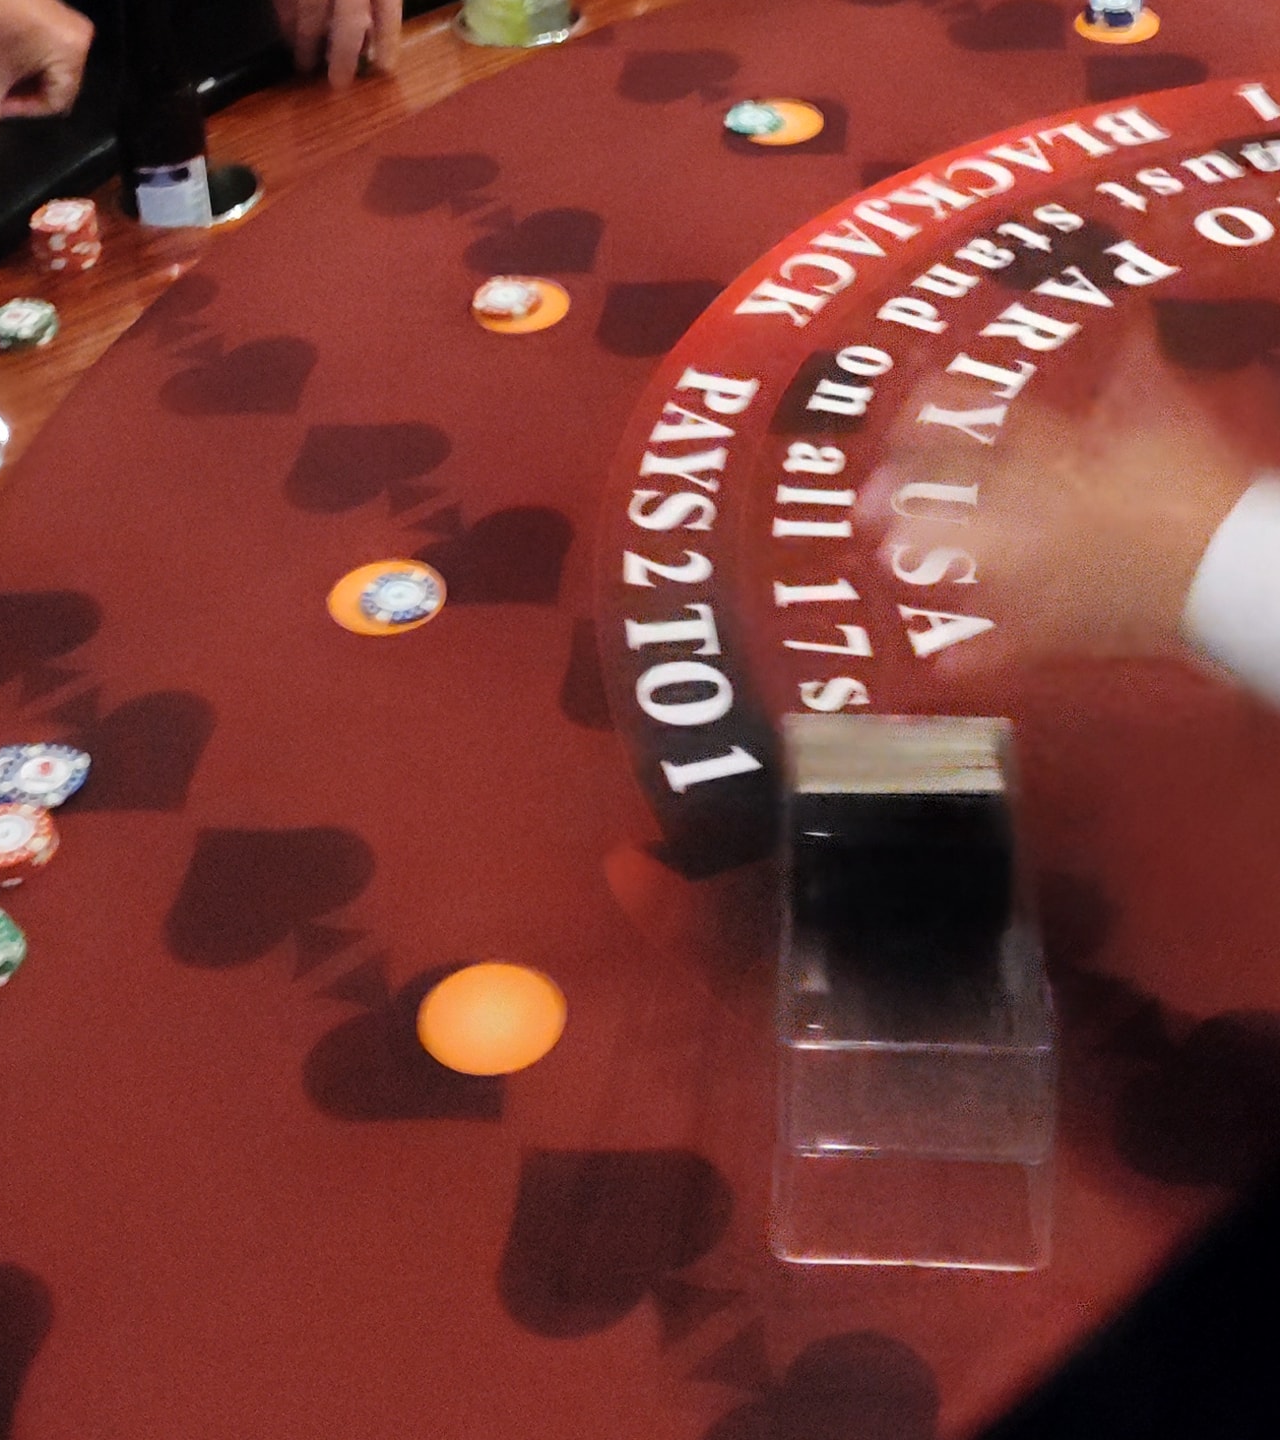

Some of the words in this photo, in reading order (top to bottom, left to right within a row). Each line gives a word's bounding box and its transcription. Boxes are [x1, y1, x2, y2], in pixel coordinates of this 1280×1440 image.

[734, 107, 1170, 327] BLACKJACK
[876, 203, 1084, 334] stand
[806, 345, 894, 417] on
[916, 241, 1180, 446] PARTY
[628, 367, 760, 532] PAYS
[772, 443, 856, 538] all
[623, 550, 712, 588] 2
[890, 482, 994, 658] USA
[623, 604, 734, 726] TO
[774, 578, 873, 713] 17s
[660, 745, 763, 794] 1
